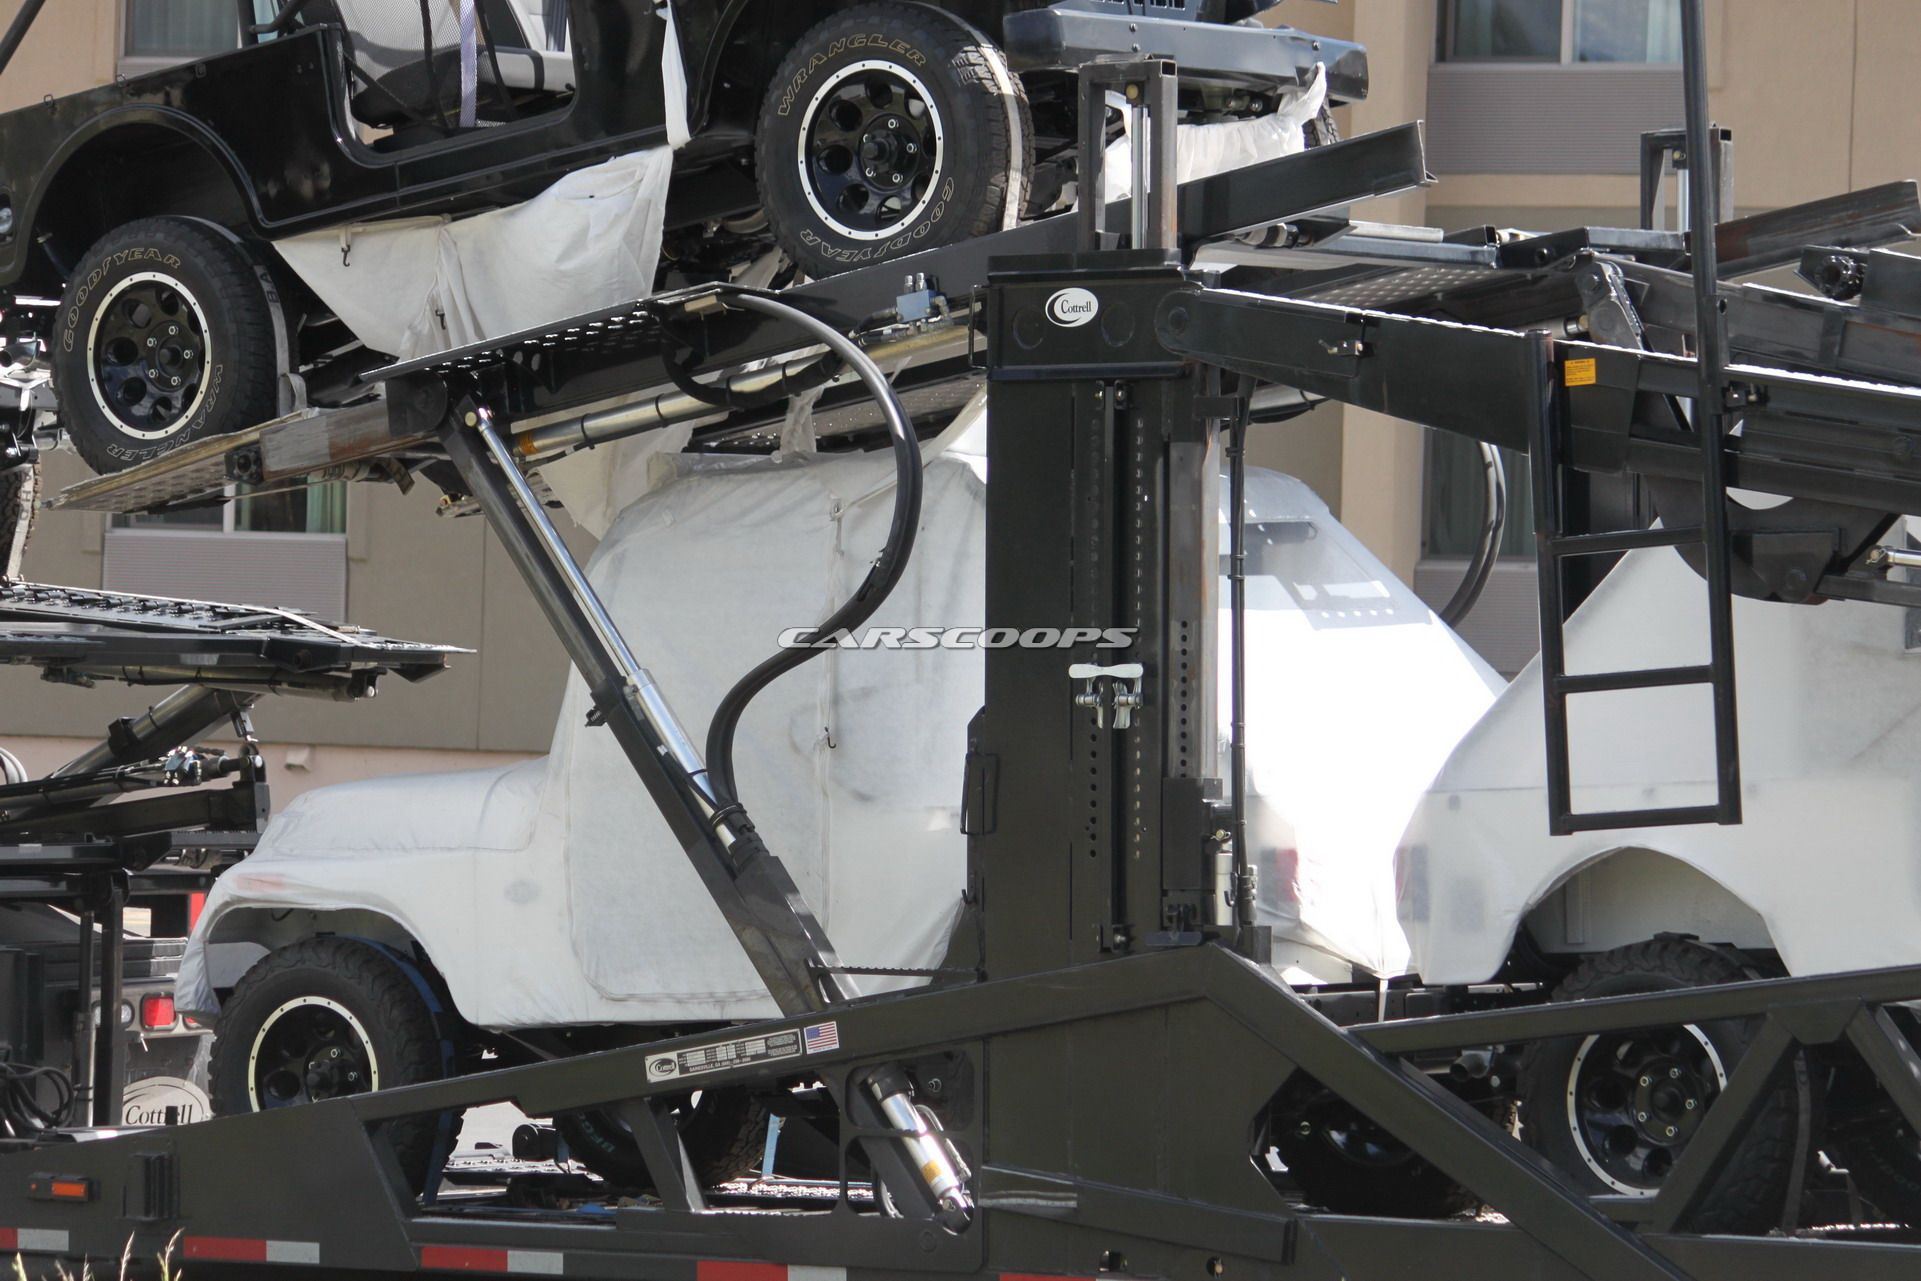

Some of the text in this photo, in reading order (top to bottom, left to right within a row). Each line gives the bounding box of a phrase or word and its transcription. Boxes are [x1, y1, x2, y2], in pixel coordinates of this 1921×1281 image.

[777, 33, 926, 116] WRANGLER
[800, 176, 955, 262] GOODYEAR
[63, 247, 181, 352] GOODYEAR
[1060, 299, 1092, 314] Cottrell
[106, 364, 224, 462] WRANGLER
[125, 1103, 193, 1125] Cottll
